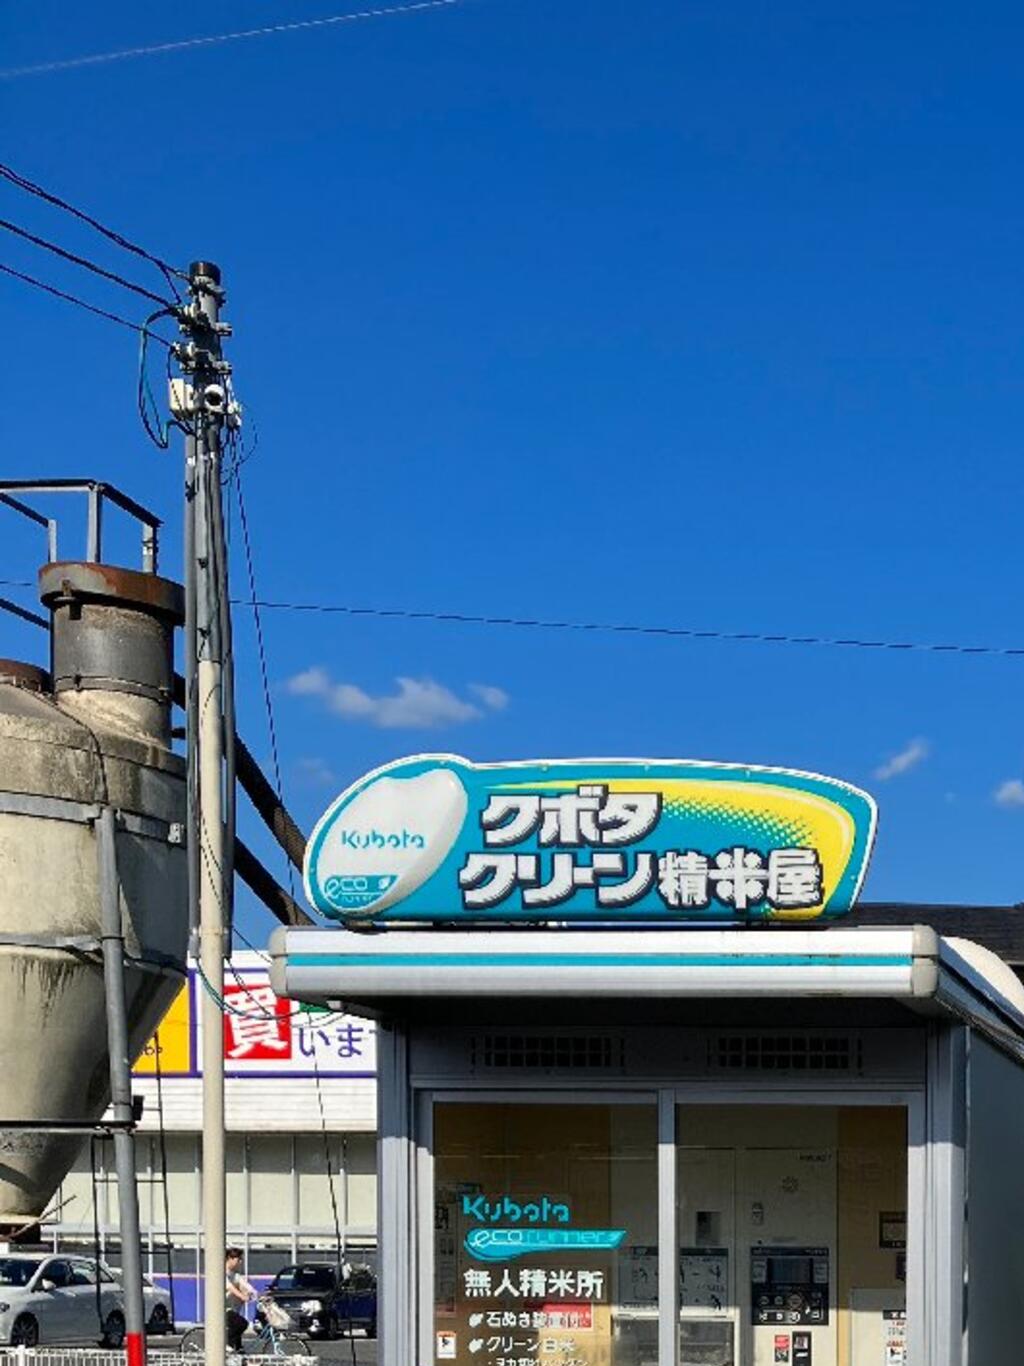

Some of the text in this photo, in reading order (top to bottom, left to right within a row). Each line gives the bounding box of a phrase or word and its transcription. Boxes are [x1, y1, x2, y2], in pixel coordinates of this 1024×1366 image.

[484, 785, 661, 846] クボタ
[342, 829, 424, 848] Kubota
[459, 849, 822, 908] クリーン精米屋
[464, 1195, 570, 1222] Kubota
[464, 1269, 603, 1299] 無人精米所
